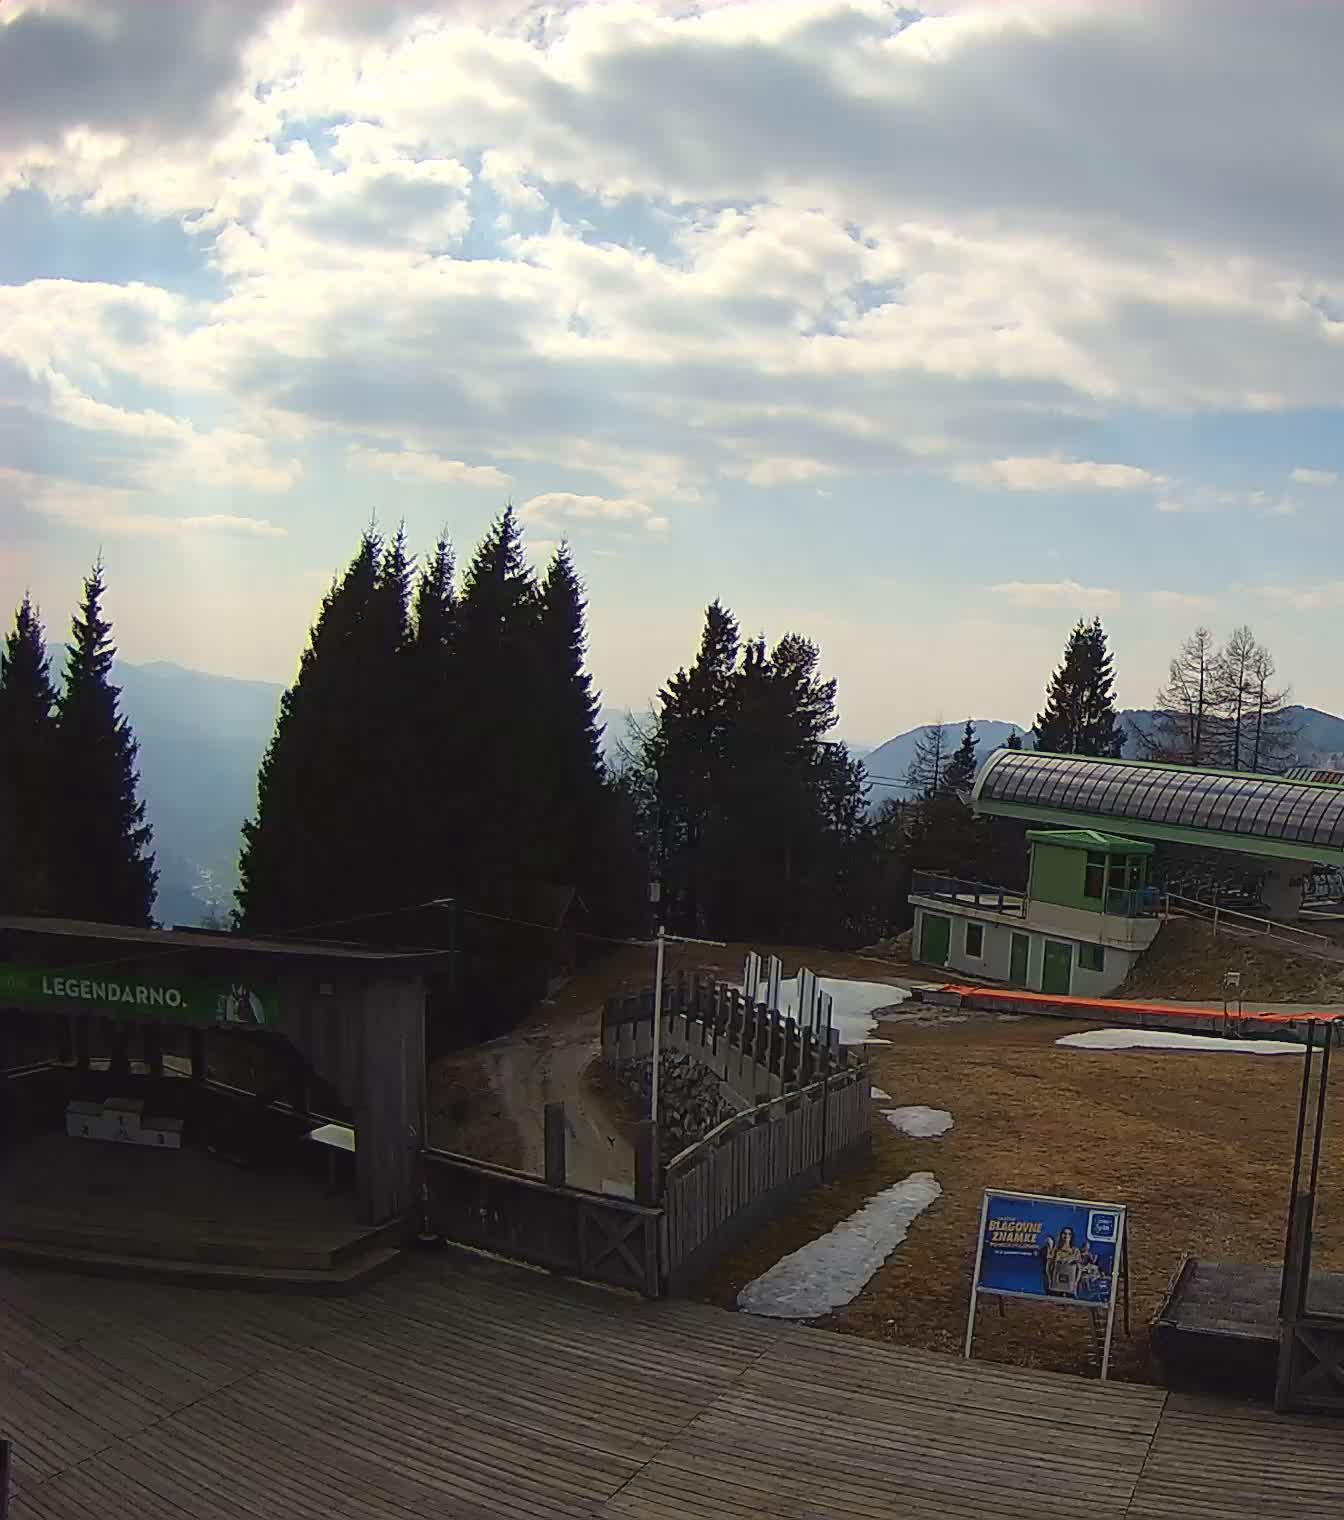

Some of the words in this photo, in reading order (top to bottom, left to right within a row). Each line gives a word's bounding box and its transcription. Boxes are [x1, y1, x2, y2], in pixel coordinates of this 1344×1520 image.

[42, 976, 188, 1008] LEGENDARNO.
[988, 1219, 1043, 1233] BLAGOVNE
[991, 1231, 1038, 1244] ZNAMKE
